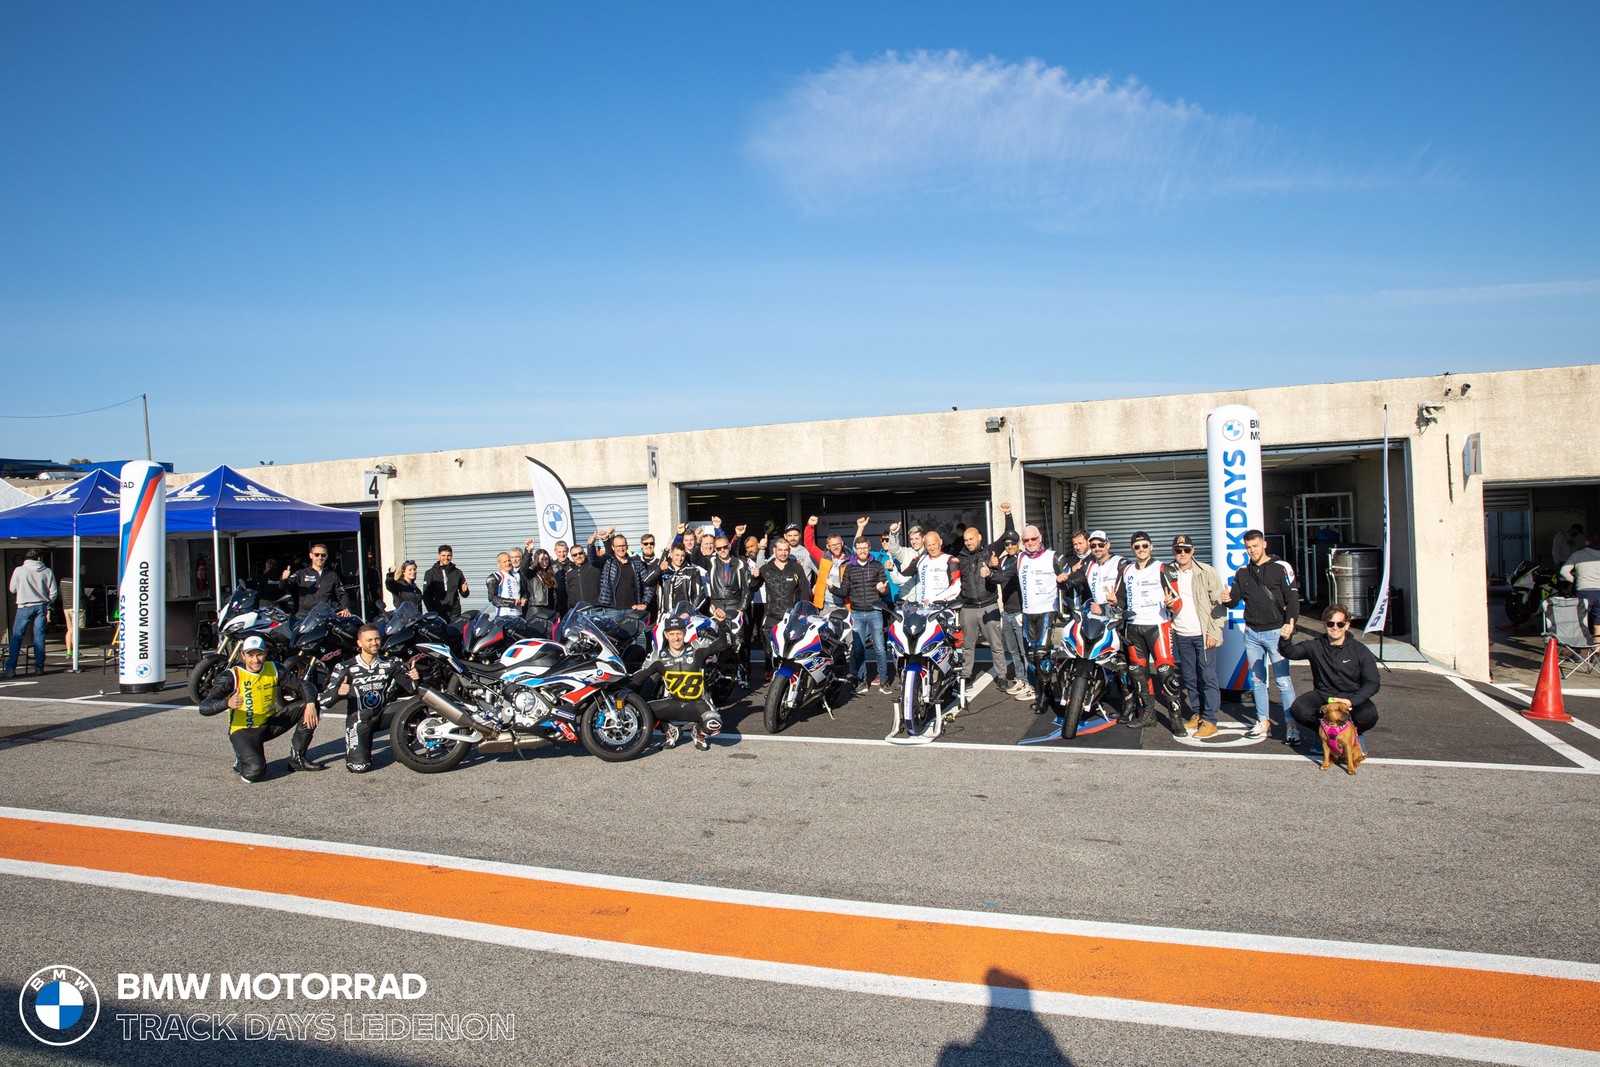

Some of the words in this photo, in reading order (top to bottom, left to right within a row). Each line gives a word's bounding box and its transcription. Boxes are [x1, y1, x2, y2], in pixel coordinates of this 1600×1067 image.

[651, 451, 657, 478] 5
[368, 475, 380, 499] 4
[1223, 449, 1249, 630] TCKDAYS
[138, 561, 149, 627] MOTORRAD
[138, 630, 149, 660] BMW
[664, 671, 704, 699] 78
